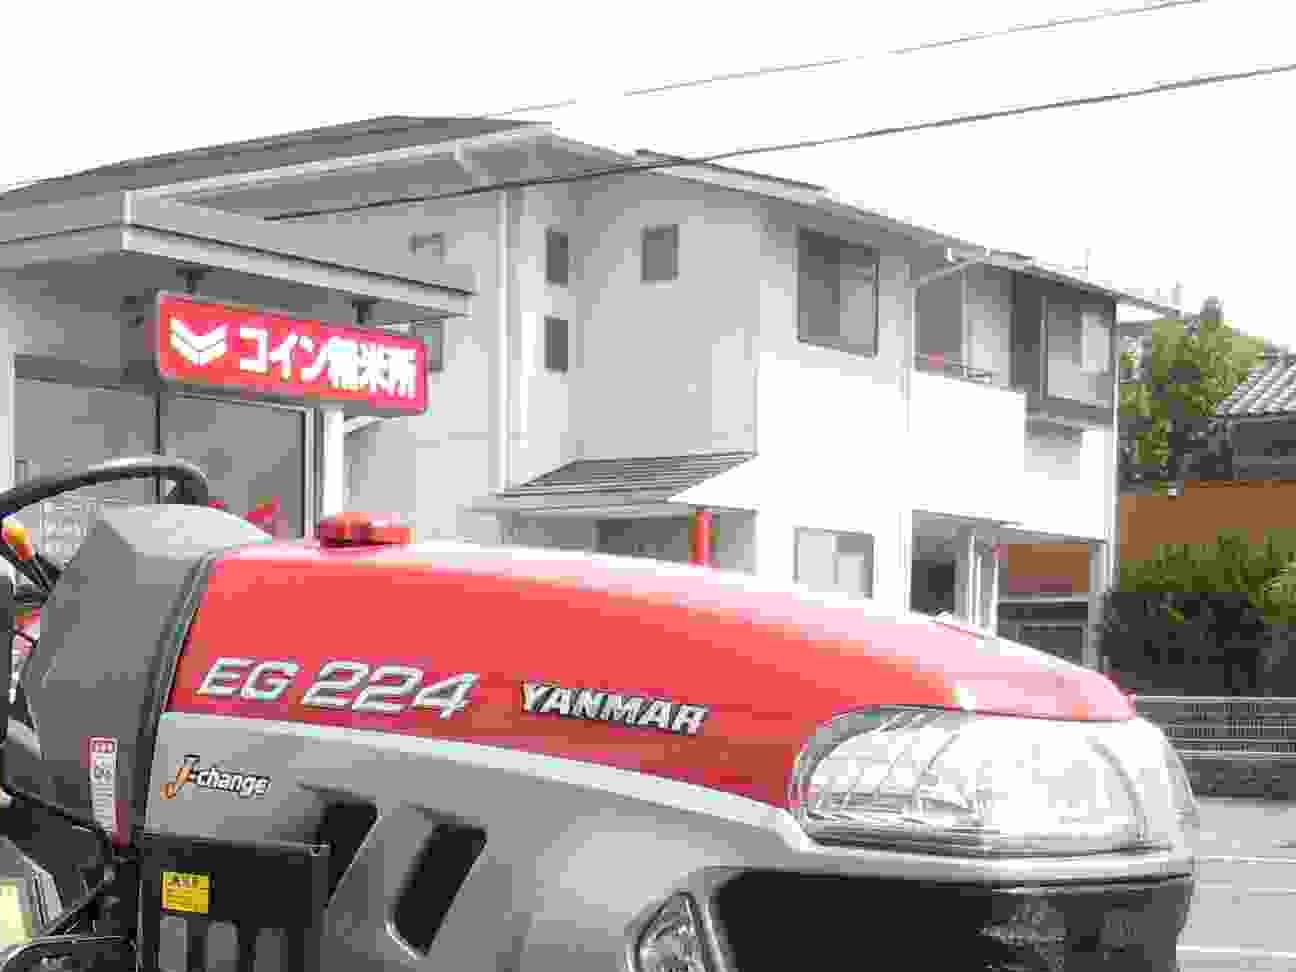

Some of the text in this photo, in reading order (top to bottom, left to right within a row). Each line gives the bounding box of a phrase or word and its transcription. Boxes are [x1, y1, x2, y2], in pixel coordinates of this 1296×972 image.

[194, 656, 481, 720] EG 224
[520, 680, 711, 736] YANMAR
